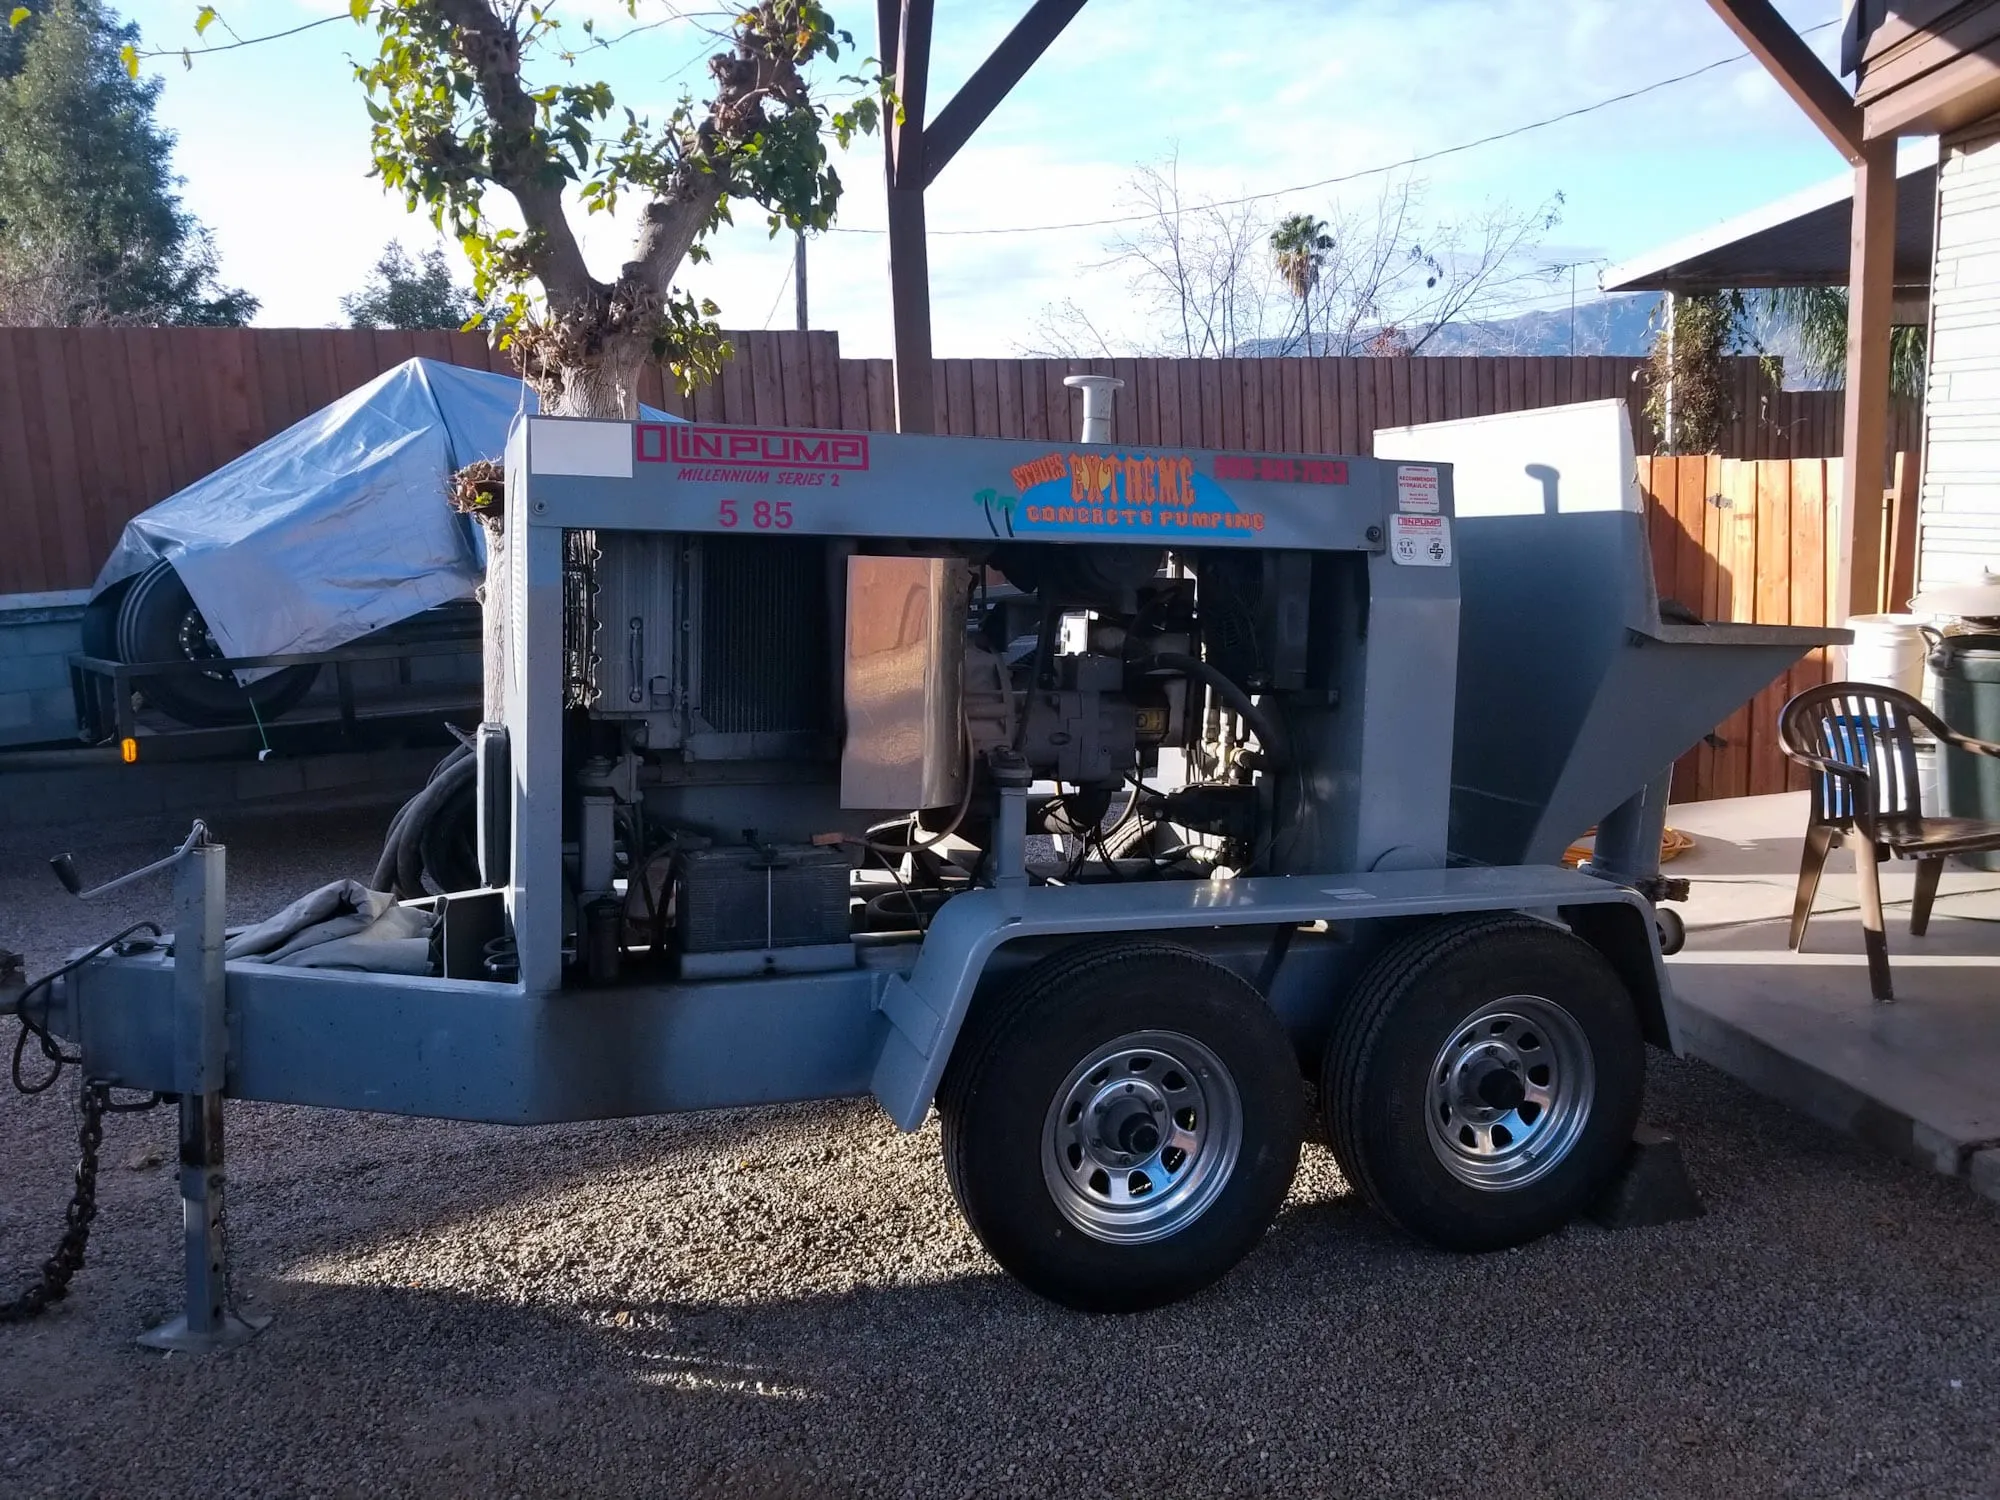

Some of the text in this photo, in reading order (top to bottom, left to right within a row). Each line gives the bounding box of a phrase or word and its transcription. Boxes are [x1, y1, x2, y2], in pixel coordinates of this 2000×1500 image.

[677, 468, 840, 487] MILLENNIUM SERIES 2
[1068, 452, 1195, 507] EXTREME
[1026, 505, 1265, 532] CONCRETE PUMPING
